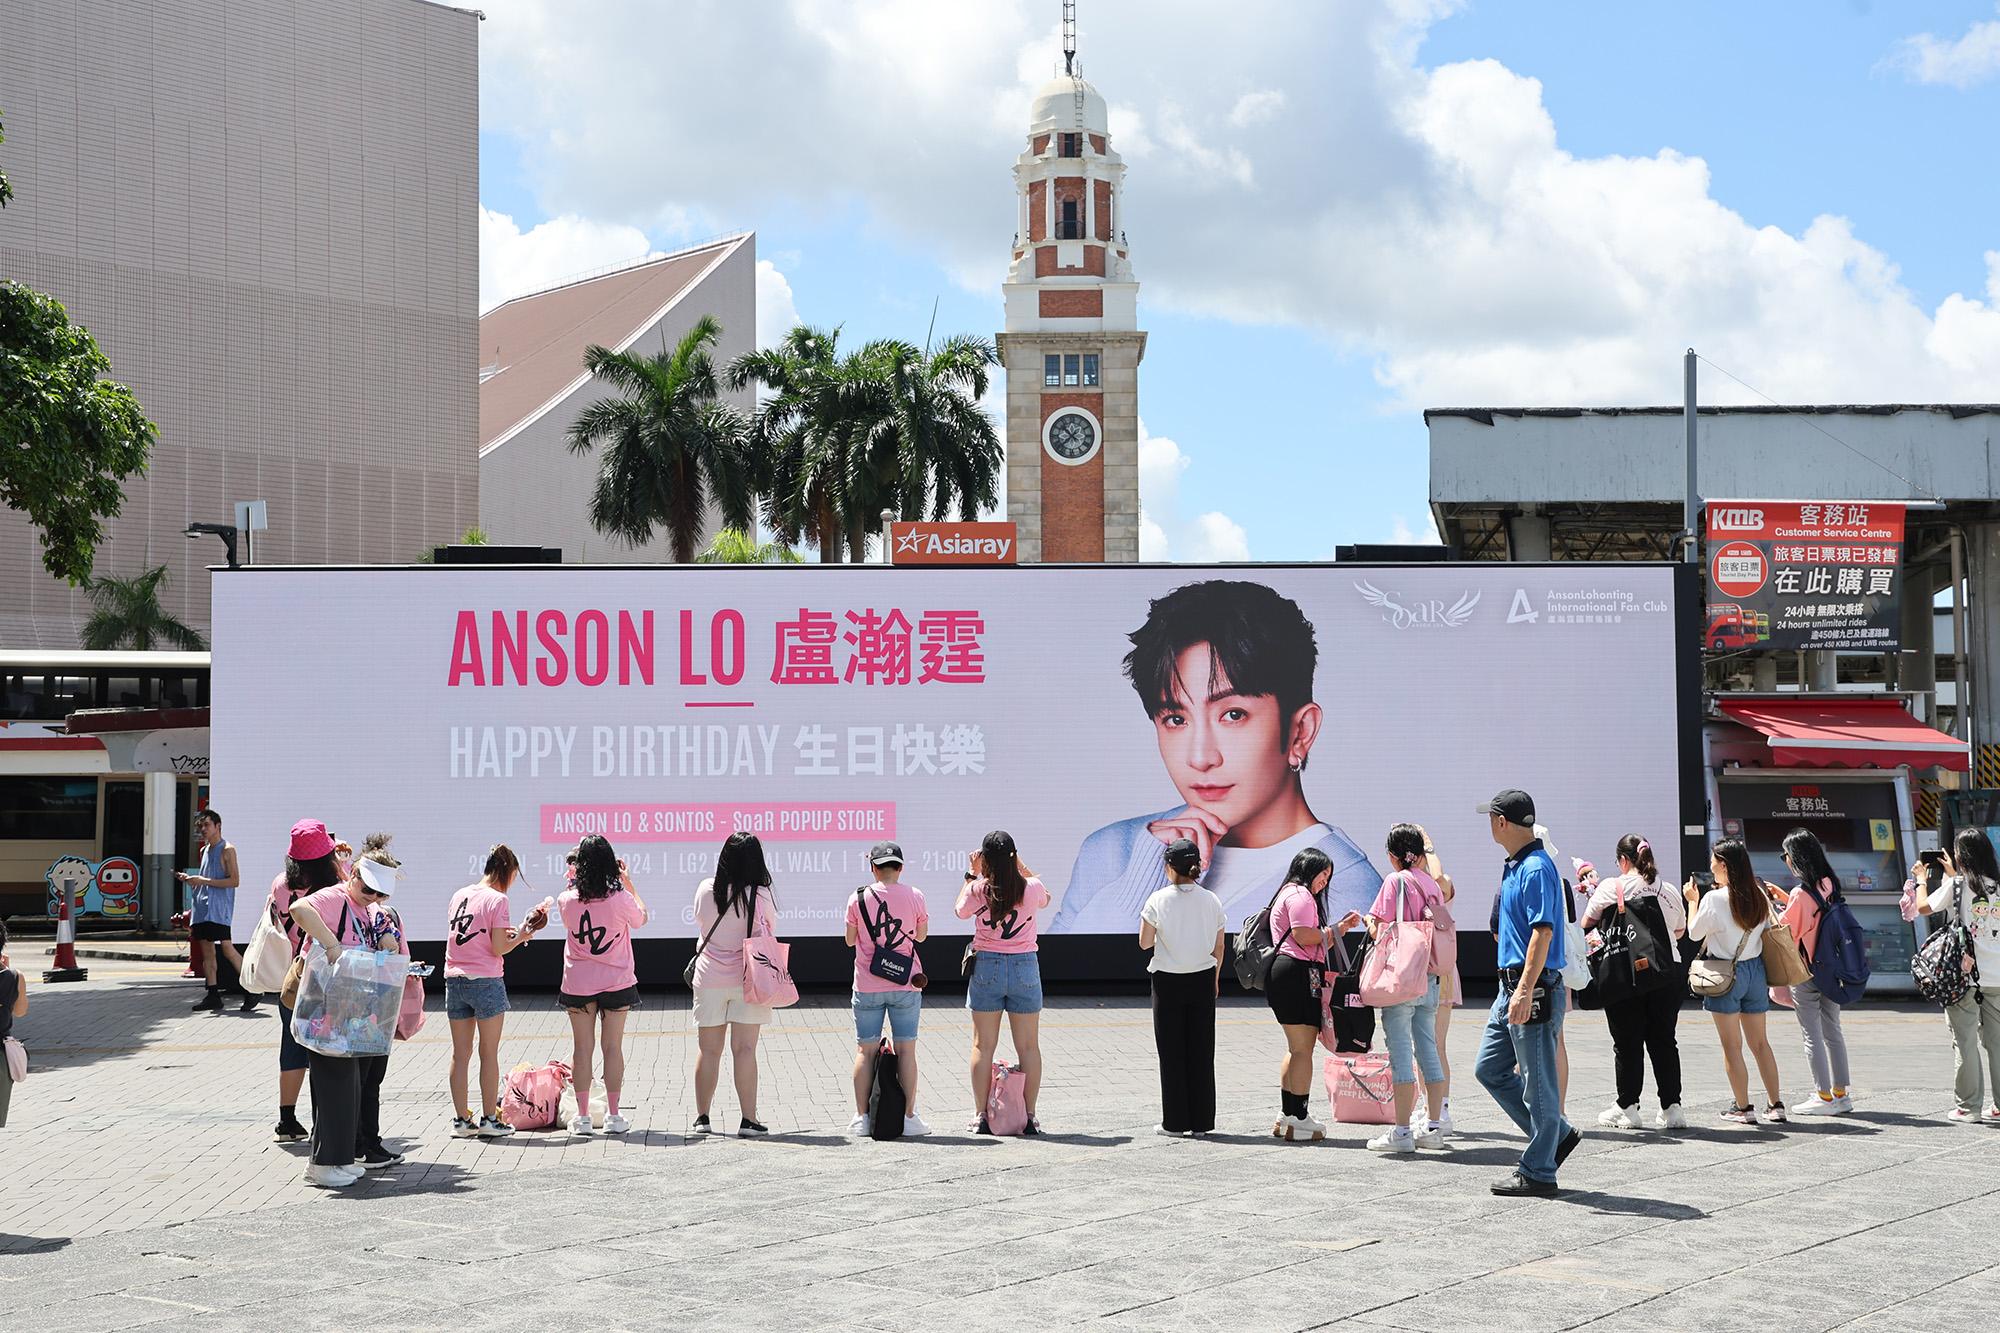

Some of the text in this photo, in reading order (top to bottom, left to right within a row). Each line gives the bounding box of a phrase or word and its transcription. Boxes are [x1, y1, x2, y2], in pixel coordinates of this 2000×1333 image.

[1712, 508, 1764, 530] KMB
[1799, 505, 1870, 526] 客務站
[1775, 527, 1892, 538] Customer Service Centre
[925, 532, 1011, 560] Asiaray
[1774, 546, 1897, 563] 旅客日票現已發售
[1774, 566, 1894, 596] 在此購買
[1547, 589, 1634, 602] AnsonLohonting
[1547, 601, 1668, 612] International Fan Club
[1784, 605, 1817, 618] 24小時
[1776, 618, 1868, 629] 24 hours unlimited rides
[447, 608, 987, 687] ANSON LO 盧瀚霆
[1851, 639, 1862, 647] and
[1878, 639, 1898, 647] routes
[449, 724, 987, 778] HAPPY BIRTHDAY 生日快樂
[1785, 797, 1829, 811] 客務站
[553, 812, 607, 833] ANSON
[614, 812, 632, 832] LO
[638, 812, 649, 832] &
[654, 811, 715, 832] SONTOS
[733, 811, 774, 832] SoaR
[780, 810, 833, 832] POPUP
[837, 810, 885, 831] STORE
[679, 852, 708, 873] LG2
[789, 850, 832, 873] WALK
[922, 850, 967, 871] 21:00
